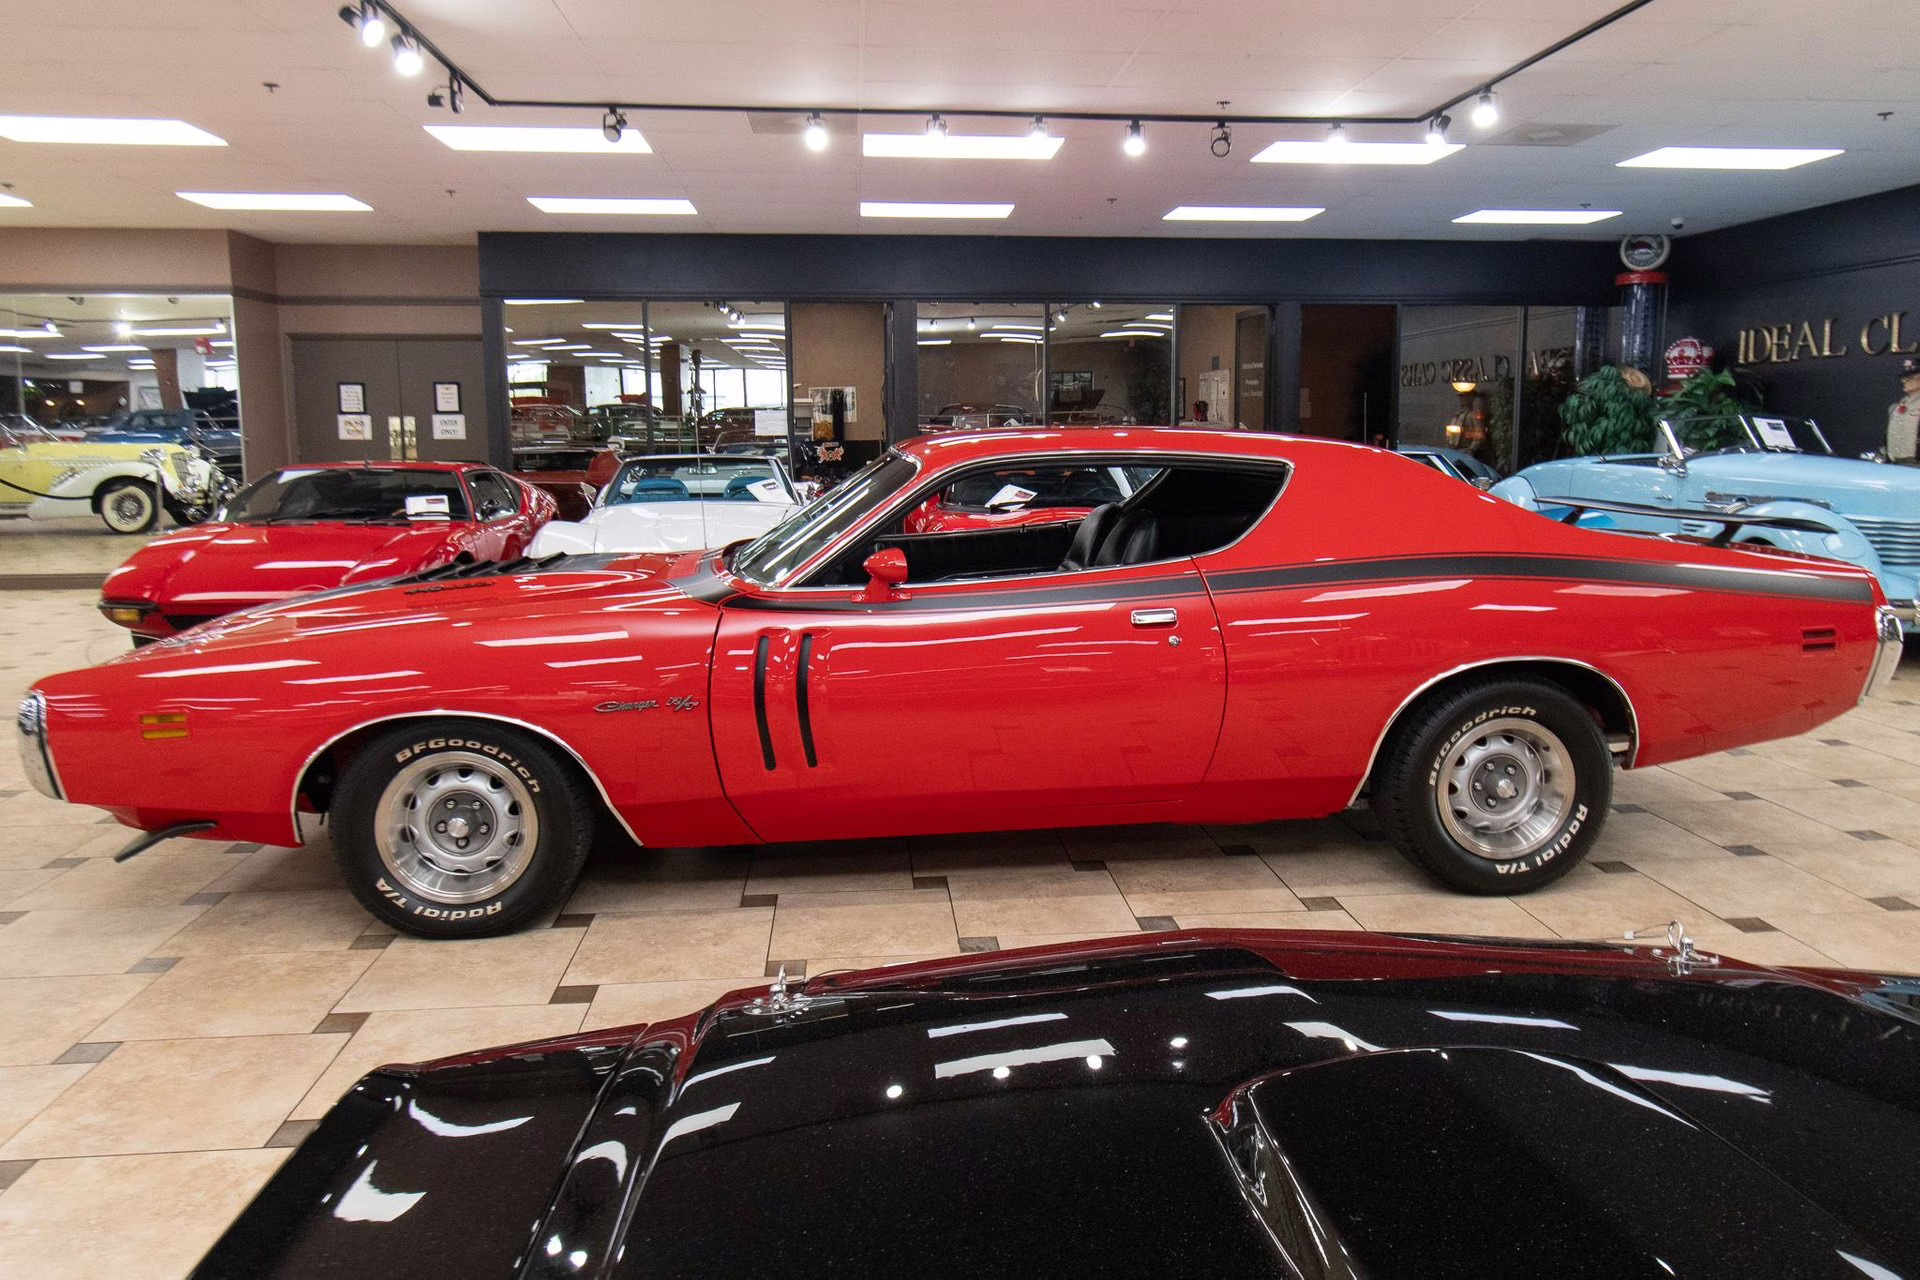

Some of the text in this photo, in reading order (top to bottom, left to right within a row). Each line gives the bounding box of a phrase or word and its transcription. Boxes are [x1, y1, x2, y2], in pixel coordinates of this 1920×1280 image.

[1738, 311, 1920, 364] IDEAL CL
[594, 700, 659, 712] Charger
[395, 738, 541, 793] BFGoodrich
[1429, 706, 1537, 786] BFGoodrich
[1495, 803, 1588, 874] Radial T/A
[375, 877, 502, 921] Radial T/A
